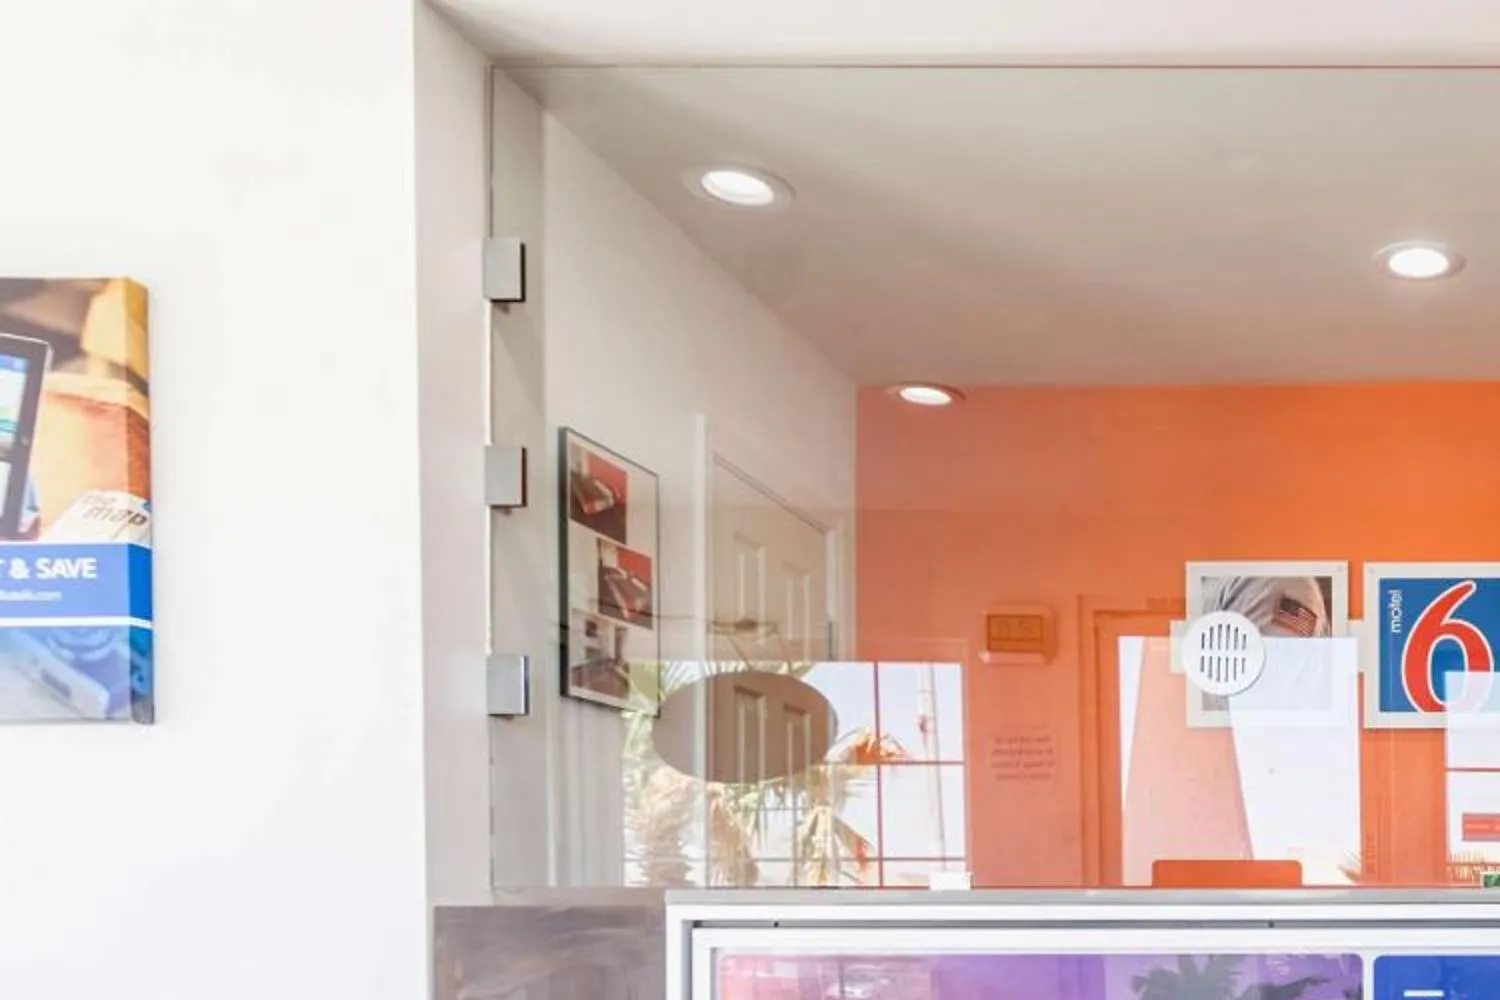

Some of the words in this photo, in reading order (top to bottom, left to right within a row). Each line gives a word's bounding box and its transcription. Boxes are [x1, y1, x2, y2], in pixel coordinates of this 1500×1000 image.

[9, 558, 30, 579] &
[35, 557, 97, 579] SAVE
[1388, 590, 1402, 633] motel
[1401, 580, 1494, 713] 6
